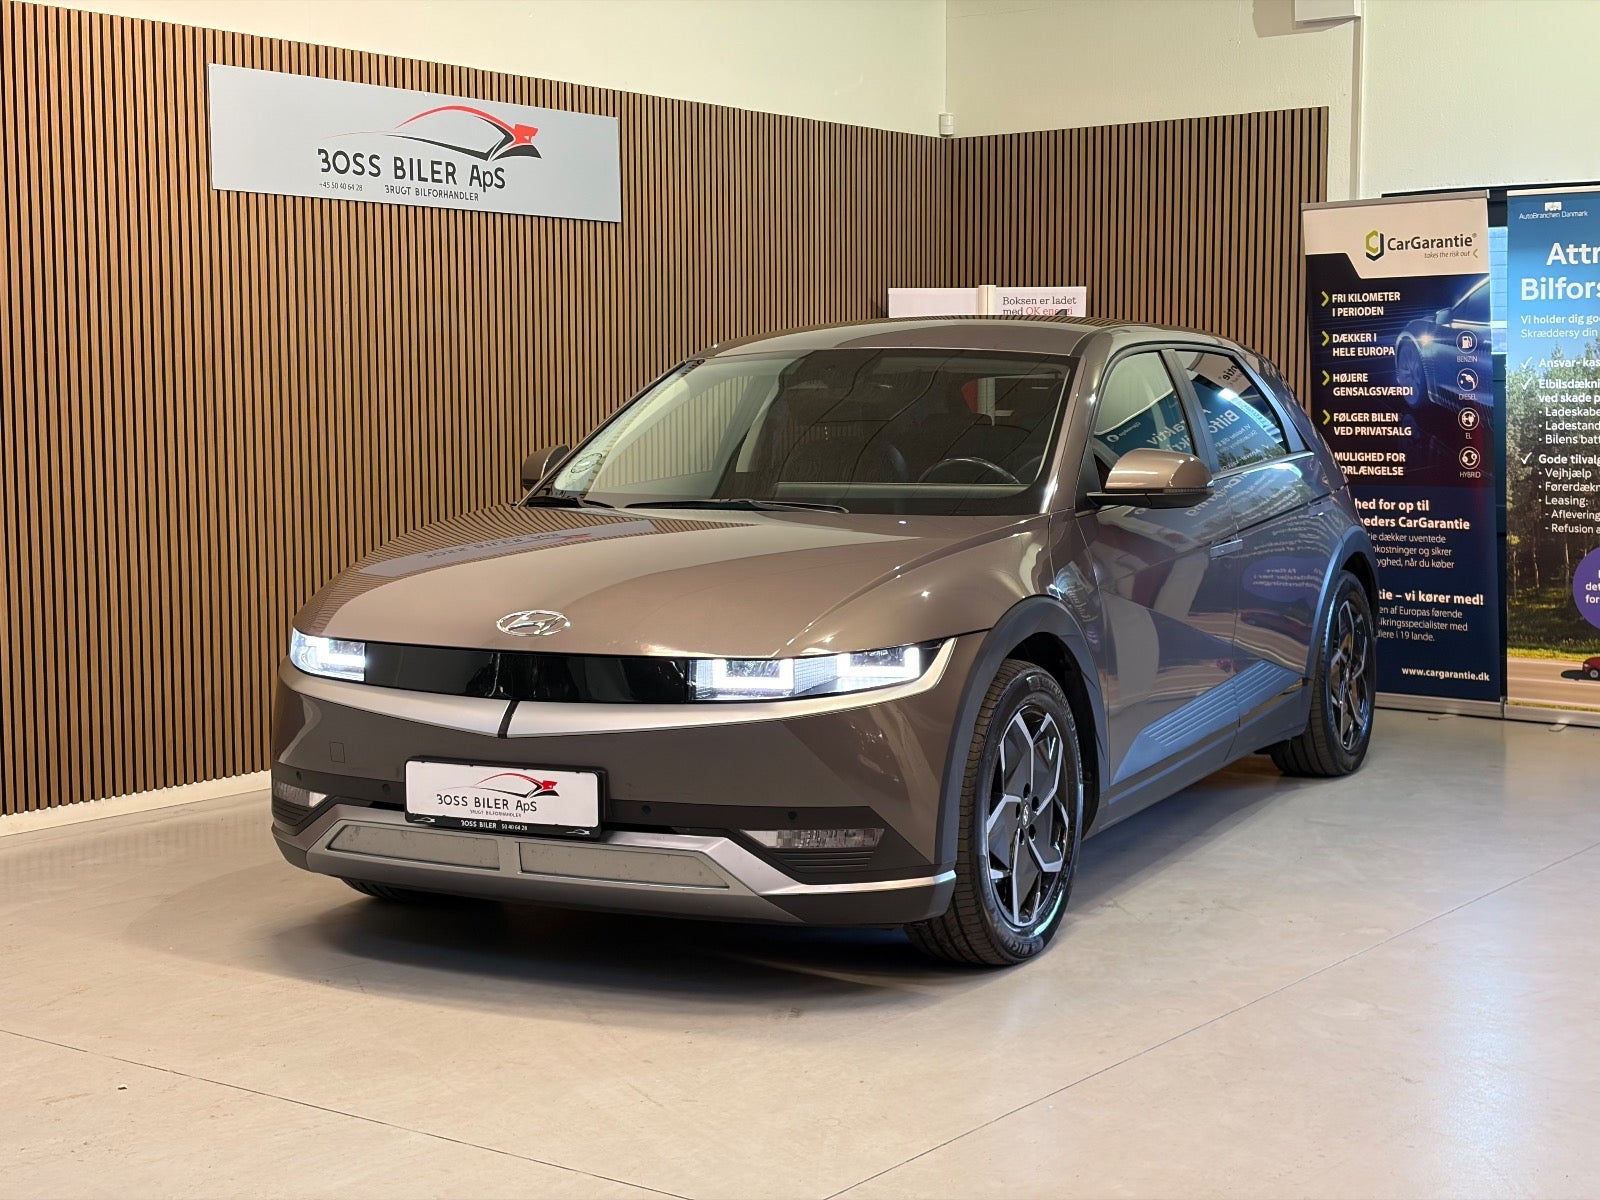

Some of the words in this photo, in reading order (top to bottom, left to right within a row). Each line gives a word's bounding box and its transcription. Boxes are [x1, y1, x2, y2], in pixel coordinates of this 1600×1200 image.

[394, 156, 457, 186] BILER
[469, 164, 506, 192] ApS
[416, 188, 479, 201] BILFORHANDLER
[1519, 212, 1560, 220] AutoBranchen
[1002, 296, 1037, 305] Boksen
[1052, 296, 1077, 305] ladet
[1332, 292, 1346, 304] FRI
[1348, 292, 1400, 303] KILOMETER
[1002, 307, 1024, 315] med
[1026, 307, 1041, 315] OK
[1338, 306, 1384, 316] PERIODEN
[1520, 315, 1532, 324] Vi
[1533, 314, 1566, 324] holder
[1569, 314, 1585, 325] dig
[1333, 333, 1371, 343] DÆKKER
[1520, 328, 1579, 339] Skræddersy
[1582, 328, 1598, 337] din
[1333, 347, 1356, 356] HELE
[1358, 346, 1395, 356] EUROPA
[1538, 358, 1580, 368] Ansvar-
[1333, 373, 1368, 383] HØJERE
[1333, 386, 1413, 397] GENSALGSVÆRDI
[1538, 393, 1559, 403] ved
[1561, 393, 1591, 403] skade
[1334, 412, 1369, 422] FØLGER
[1371, 413, 1398, 422] BILEN
[1334, 426, 1353, 436] VED
[1355, 426, 1412, 436] PRIVATSALG
[1545, 435, 1577, 444] Bilens
[1334, 451, 1384, 461] MULIGHED
[1386, 453, 1406, 462] FOR
[1538, 455, 1568, 464] Gode
[1545, 468, 1592, 480] Vejhjælp
[1379, 499, 1396, 511] for
[1398, 501, 1414, 513] op
[1416, 500, 1429, 511] til
[1545, 496, 1589, 507] Leasing:
[1551, 510, 1600, 522] Aflevering
[1399, 517, 1470, 530] CarGarantie
[1551, 524, 1593, 534] Refusion
[1379, 534, 1407, 543] dækker
[1409, 535, 1446, 543] uventede
[1418, 548, 1430, 557] og
[1431, 547, 1452, 556] sikrer
[1404, 558, 1417, 567] når
[1419, 559, 1430, 568] du
[1432, 560, 1455, 569] køber
[1405, 590, 1416, 601] vi
[1418, 591, 1451, 604] kører
[1454, 593, 1484, 605] med!
[1390, 606, 1398, 615] af
[1399, 607, 1430, 618] Europas
[1432, 609, 1463, 619] førende
[1379, 618, 1449, 630] ikringsspecialister
[1450, 622, 1468, 631] med
[1400, 631, 1410, 640] 19
[1411, 632, 1435, 641] lande.
[1401, 667, 1490, 682] www.cargarantie.dk
[474, 797, 509, 810] BILER
[515, 800, 537, 813] ApS
